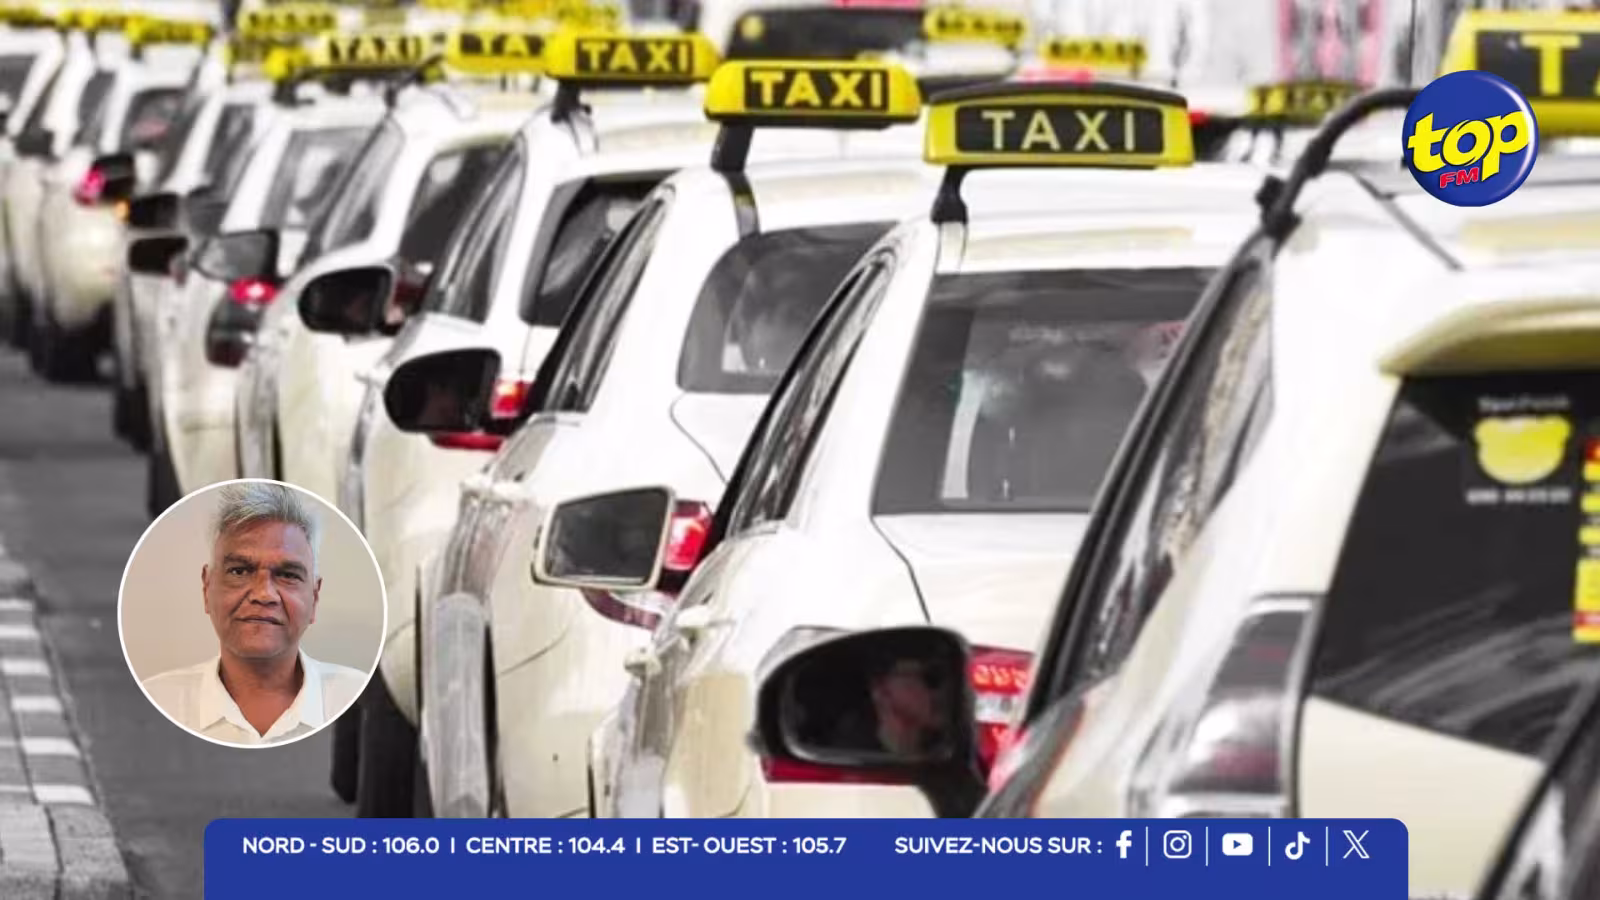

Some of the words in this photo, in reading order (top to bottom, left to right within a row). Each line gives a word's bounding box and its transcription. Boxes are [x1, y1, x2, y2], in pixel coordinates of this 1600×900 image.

[331, 35, 416, 62] TAXI
[479, 33, 532, 57] TA
[580, 38, 689, 72] TAXI
[750, 70, 883, 108] TAXI
[981, 110, 1136, 152] TAXI
